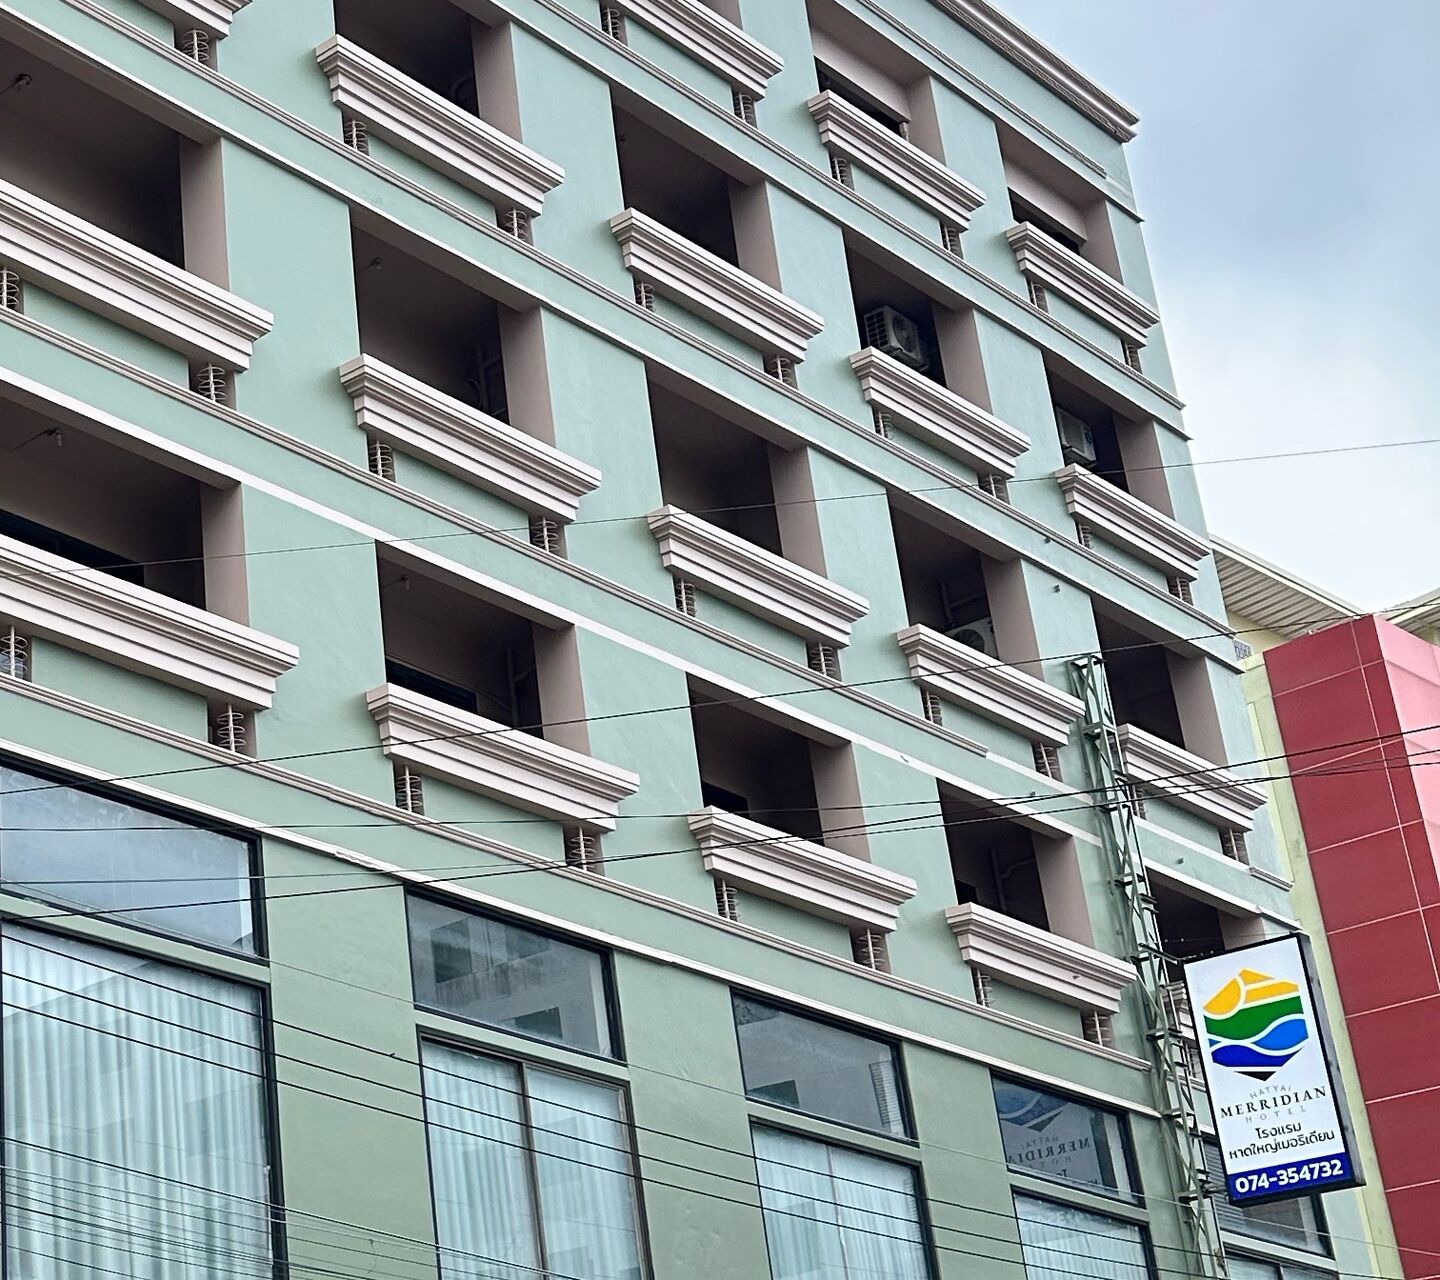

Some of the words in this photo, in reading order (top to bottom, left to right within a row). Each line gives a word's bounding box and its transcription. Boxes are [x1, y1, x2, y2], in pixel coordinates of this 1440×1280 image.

[1250, 1084, 1292, 1099] HATYAI
[1220, 1085, 1327, 1118] MERRIDIAN
[1245, 1105, 1307, 1123] HOTEL
[1255, 1122, 1302, 1139] โรงแรม
[1235, 1159, 1344, 1193] 074-354732
